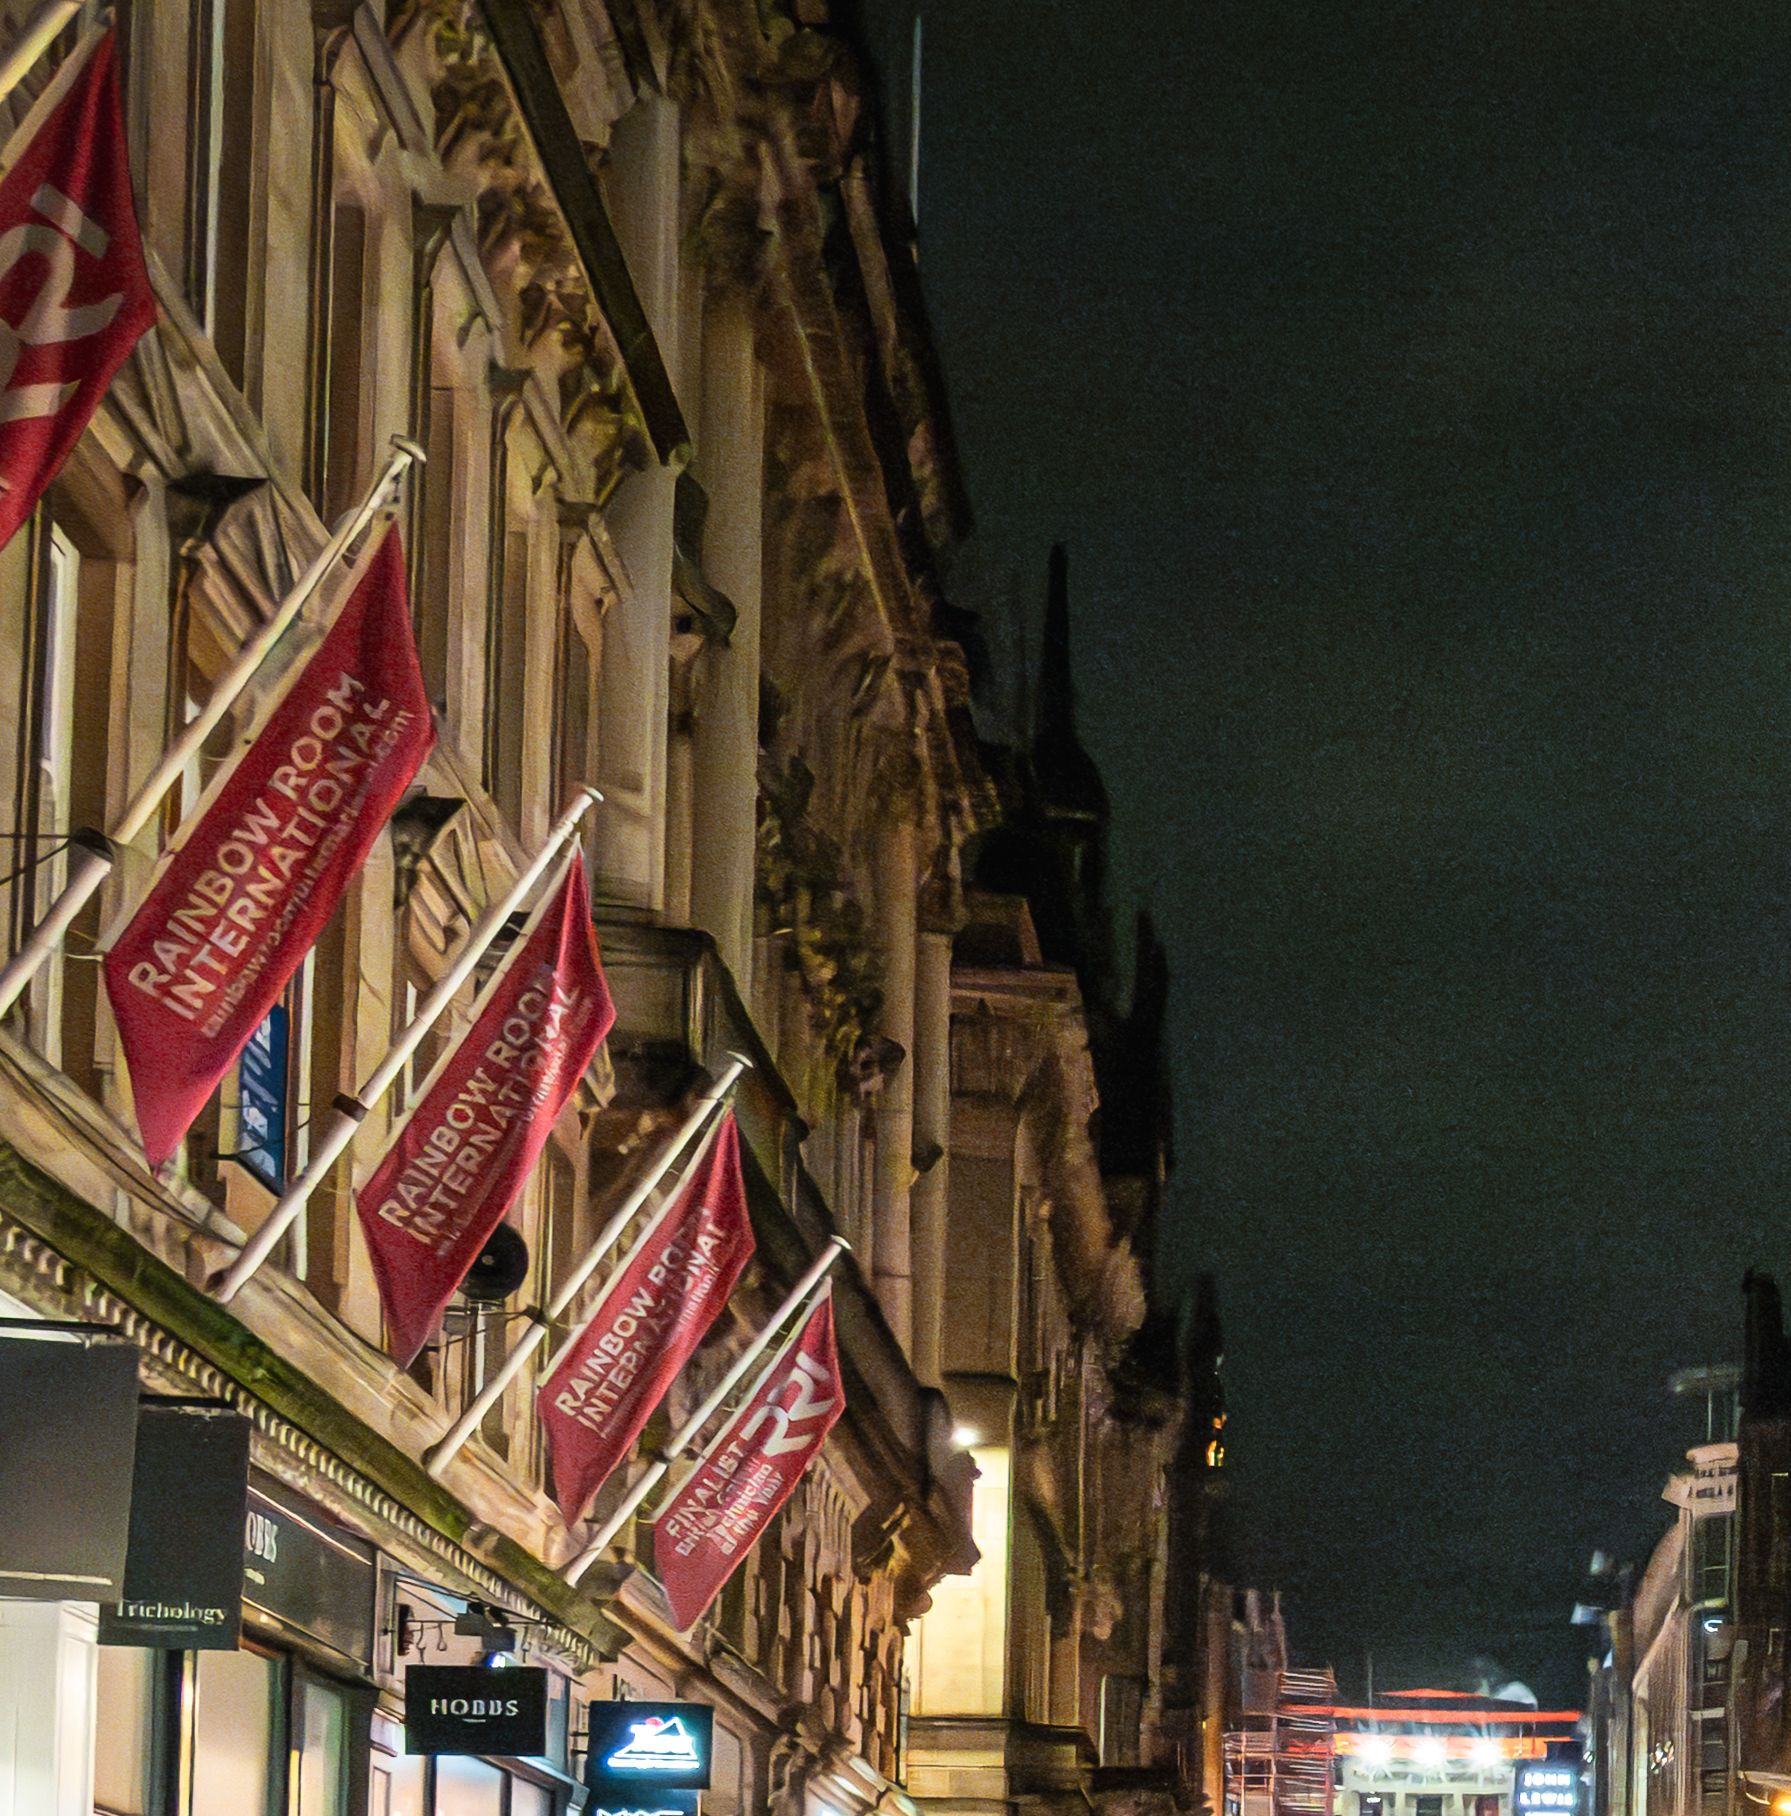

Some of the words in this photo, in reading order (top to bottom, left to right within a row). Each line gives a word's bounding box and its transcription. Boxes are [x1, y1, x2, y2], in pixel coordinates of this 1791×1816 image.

[127, 797, 281, 997] RAINBOW
[268, 671, 365, 799] ROOM
[162, 698, 391, 1020] INTERNATIONAL
[378, 1066, 497, 1228] RAINBOW
[555, 1286, 657, 1417] RAINBOW
[665, 1440, 744, 1539] FINALIST
[430, 1698, 520, 1717] HOBBS
[1519, 1791, 1574, 1806] LEWIS
